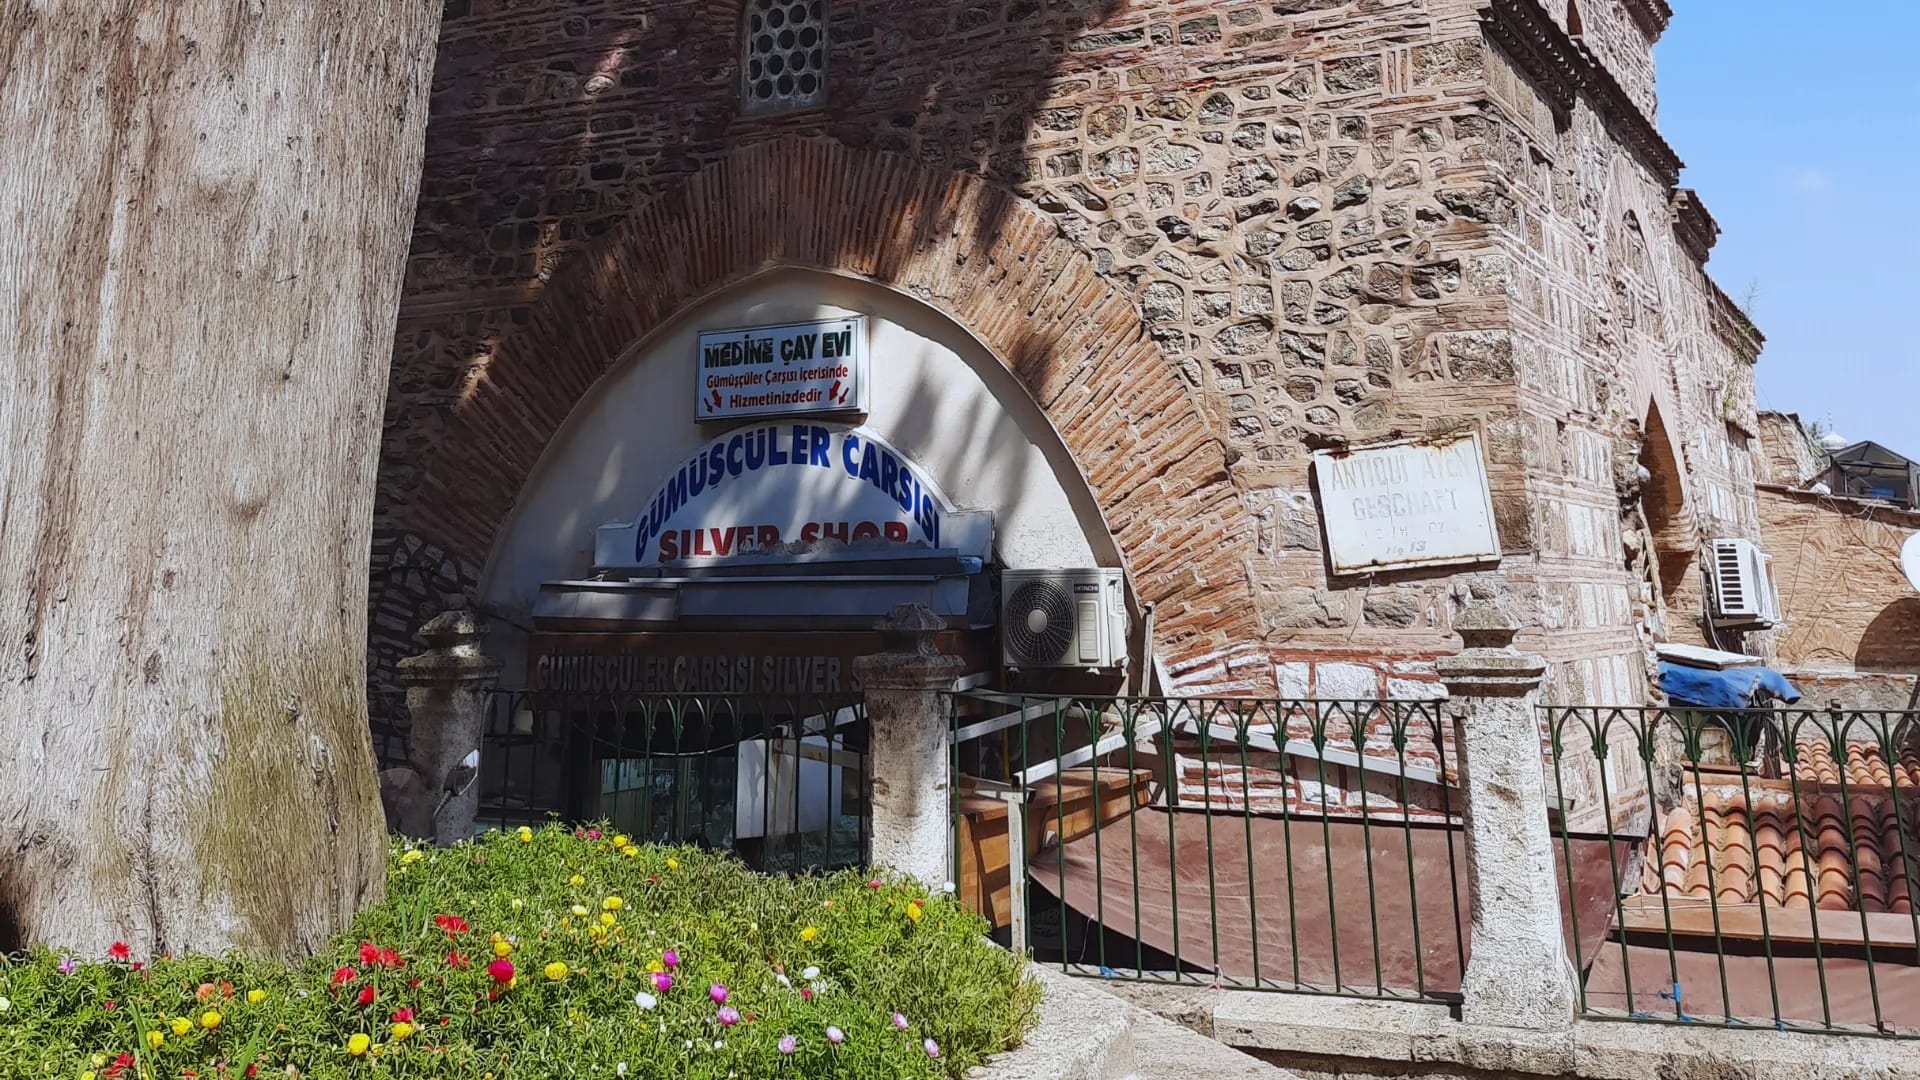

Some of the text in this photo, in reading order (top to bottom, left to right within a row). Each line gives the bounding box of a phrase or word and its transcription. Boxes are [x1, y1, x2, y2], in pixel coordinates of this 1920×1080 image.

[704, 325, 852, 369] MEDİNE ÇAY EVİ
[706, 370, 763, 390] Gümüşçüler
[765, 368, 798, 386] Çarşısı
[729, 388, 824, 409] Hizmetinizdedir
[658, 525, 780, 564] SILVER
[761, 655, 841, 693] SILVER
